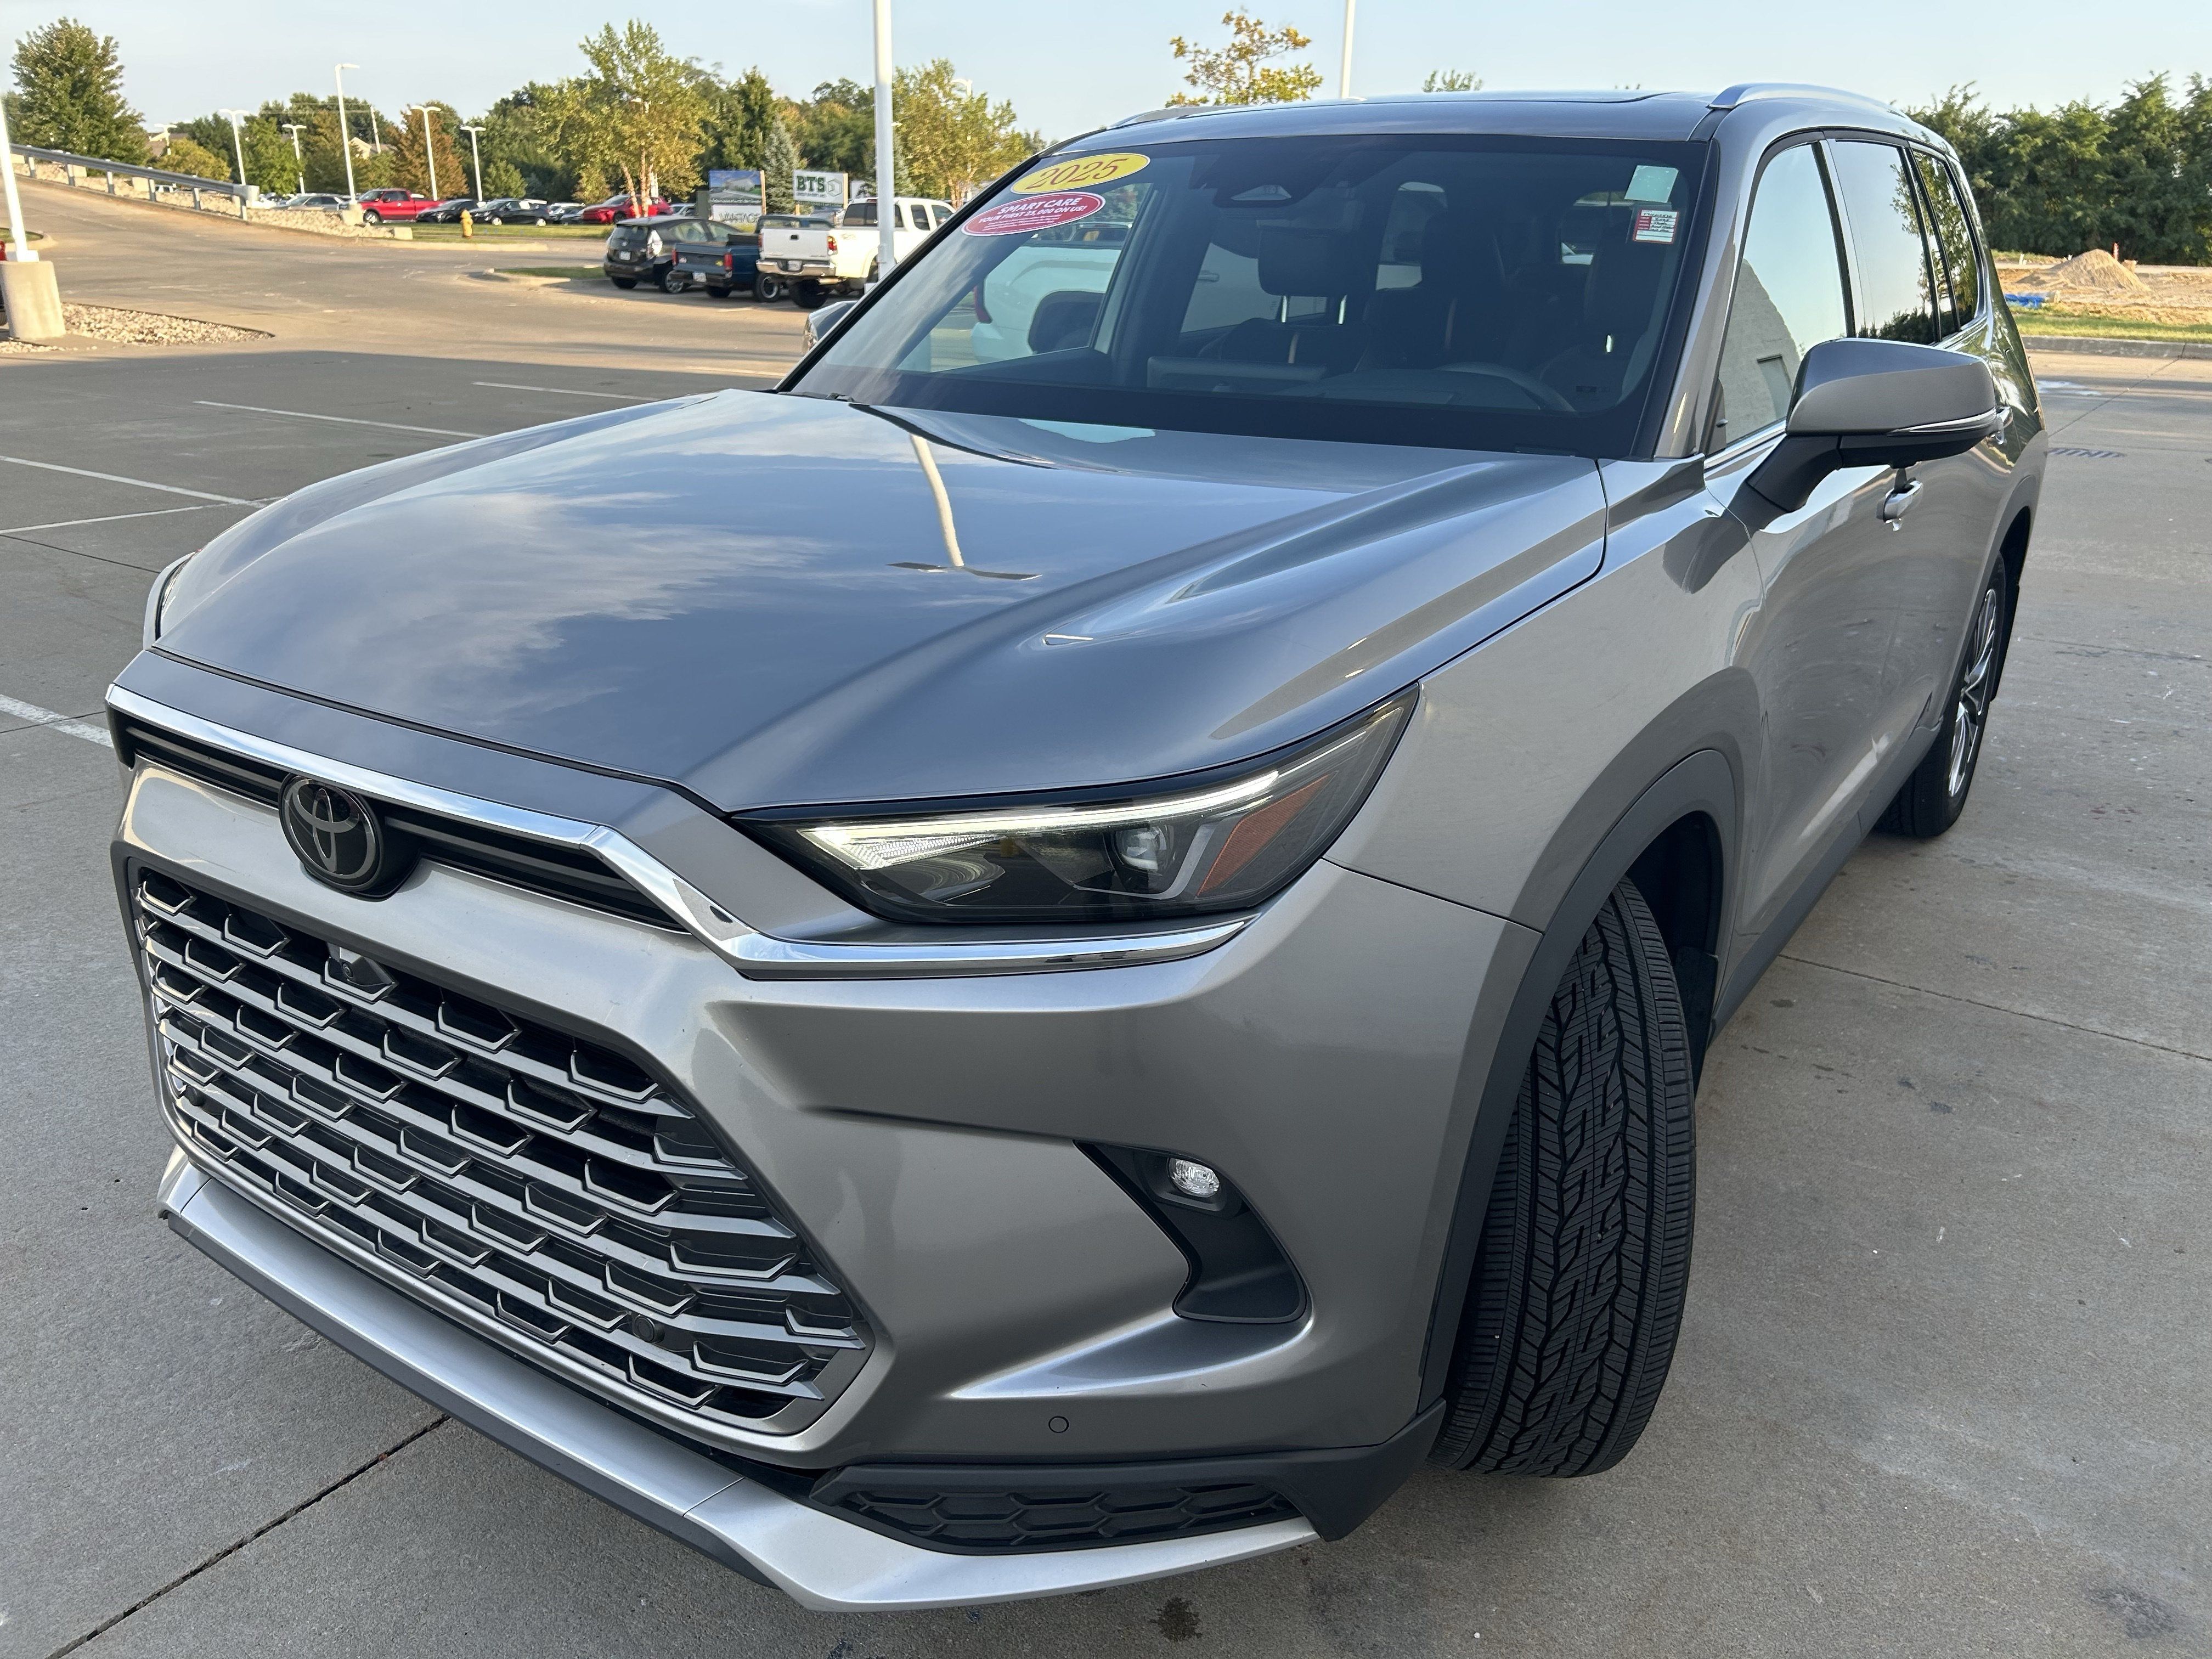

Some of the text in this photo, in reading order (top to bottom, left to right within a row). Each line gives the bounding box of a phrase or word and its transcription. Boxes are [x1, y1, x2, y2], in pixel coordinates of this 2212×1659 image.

[1025, 158, 1129, 190] 2025
[797, 175, 825, 192] BTS
[997, 198, 1082, 215] SMART CARE
[978, 215, 1001, 223] YOUR
[1025, 209, 1056, 217] 25,000
